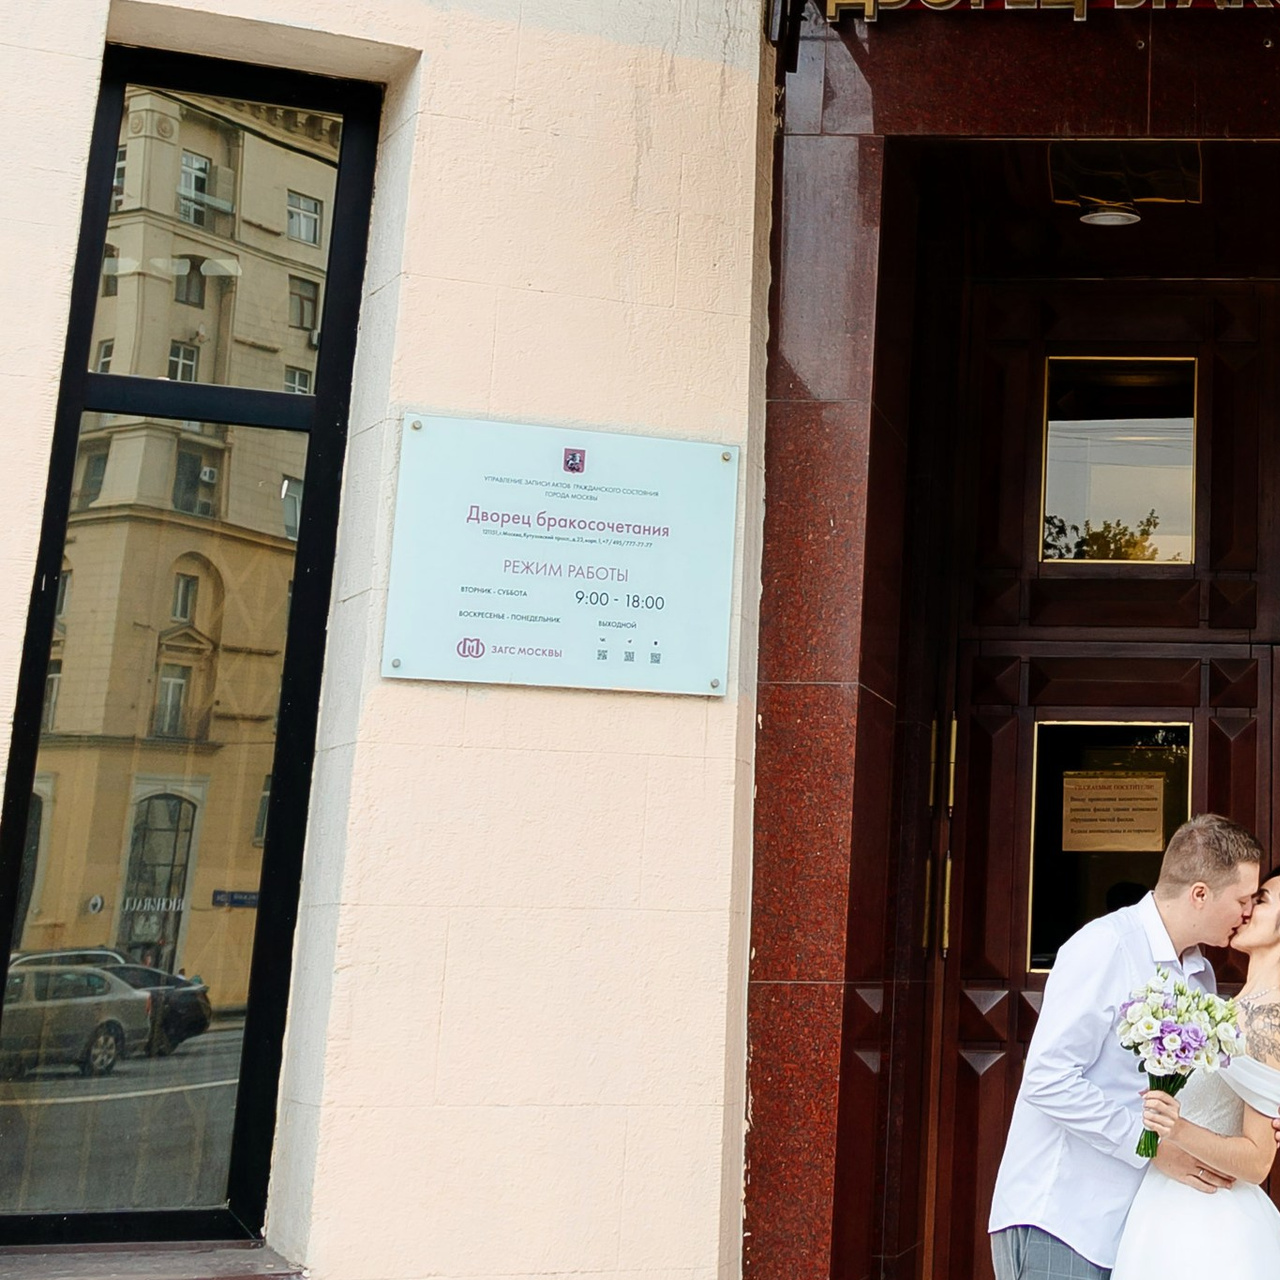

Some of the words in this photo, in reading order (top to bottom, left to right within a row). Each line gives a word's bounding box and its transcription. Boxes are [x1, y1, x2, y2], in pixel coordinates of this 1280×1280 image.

[484, 475, 523, 485] УПРАВЛЕНИЕ
[524, 478, 551, 487] ЗАПИСИ
[551, 481, 572, 489] АКТОВ
[573, 483, 622, 494] ГРАЖДАНСКОГО
[622, 488, 659, 497] СОСТОЯНИЯ
[545, 491, 569, 499] ГОРОДА
[466, 505, 531, 527] Дворец
[536, 511, 670, 537] бракосочетания
[503, 559, 563, 577] РЕЖИМ
[568, 564, 629, 582] РАБОТЫ
[460, 586, 492, 595] ВТОРНИК
[497, 588, 528, 597] СУББОТА
[575, 590, 609, 606] 9:00
[625, 594, 665, 610] 18:00
[458, 610, 505, 620] ВОСКРЕСЕНЬЕ
[510, 614, 561, 624] ПОНЕДЕЛЬНИК
[598, 620, 637, 629] ВЫХОДНОЙ
[491, 645, 516, 655] ЗАГС
[517, 648, 562, 658] МОСКВЫ
